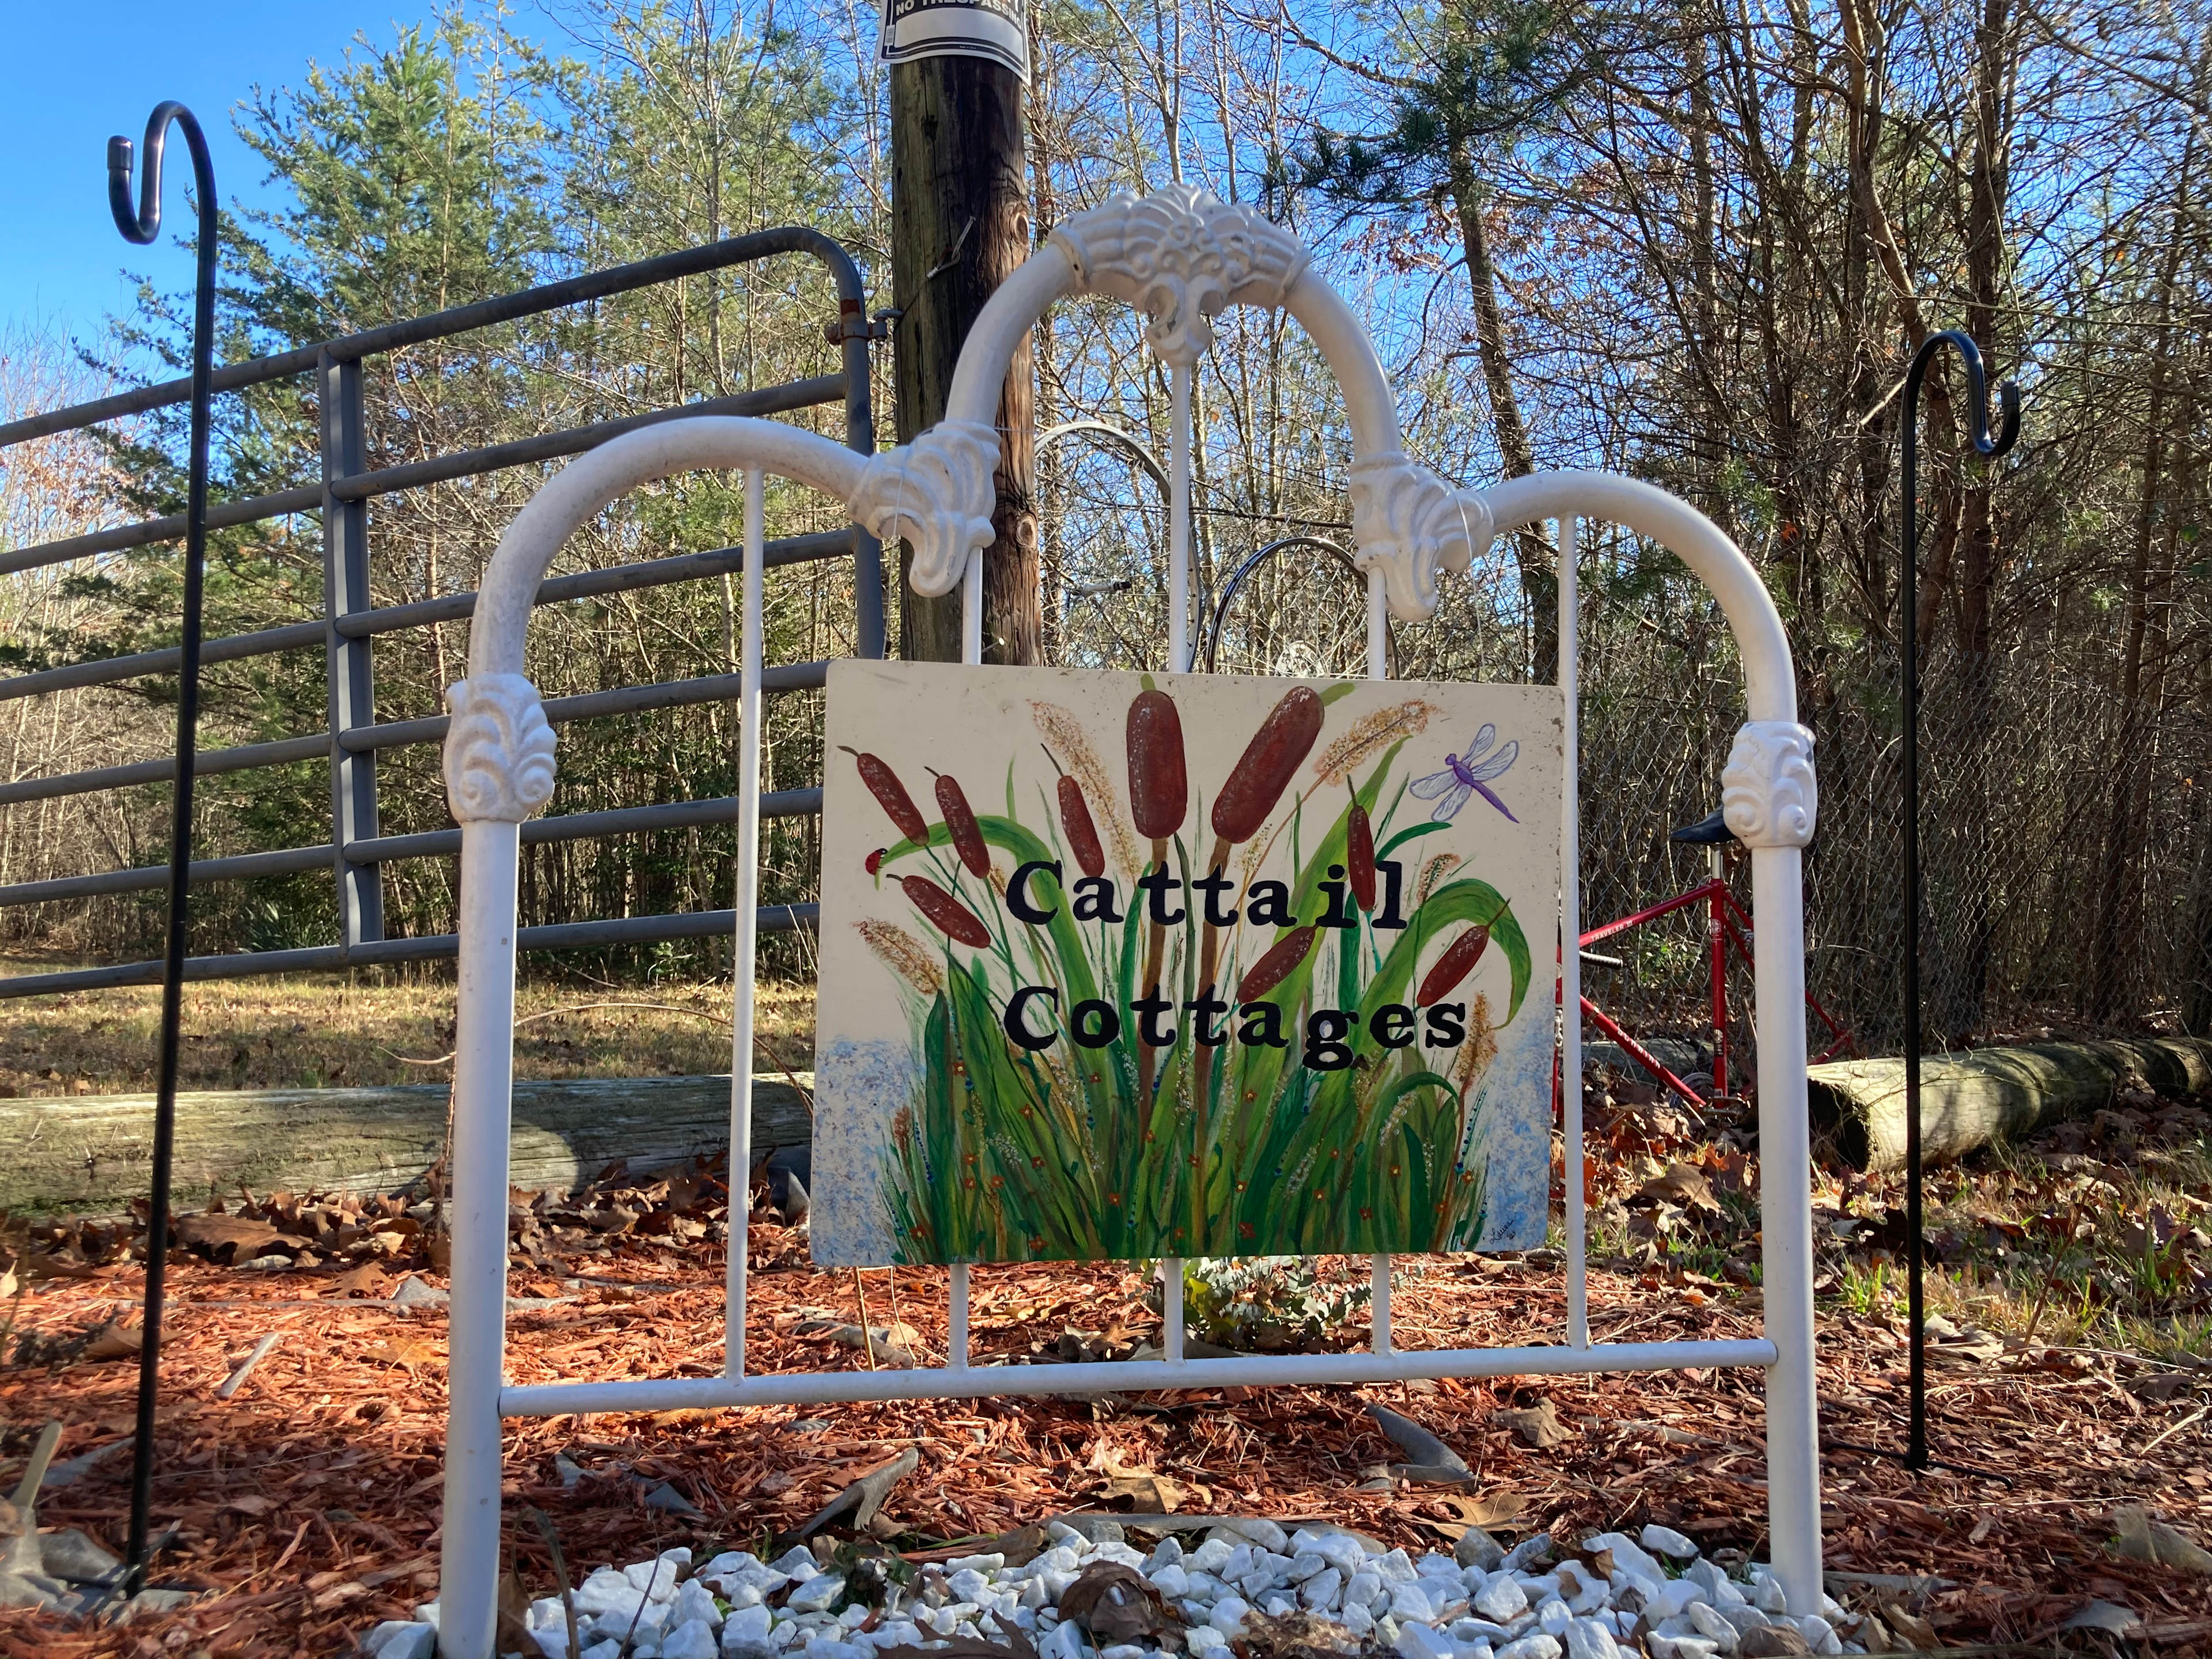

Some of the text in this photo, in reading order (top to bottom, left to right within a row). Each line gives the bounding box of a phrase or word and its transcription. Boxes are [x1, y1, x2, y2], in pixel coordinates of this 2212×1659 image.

[896, 0, 915, 16] NO
[922, 0, 1022, 30] ASSING
[1006, 859, 1408, 929] Cattail
[1591, 924, 1624, 942] TRAVELER
[1003, 983, 1466, 1071] Cottages
